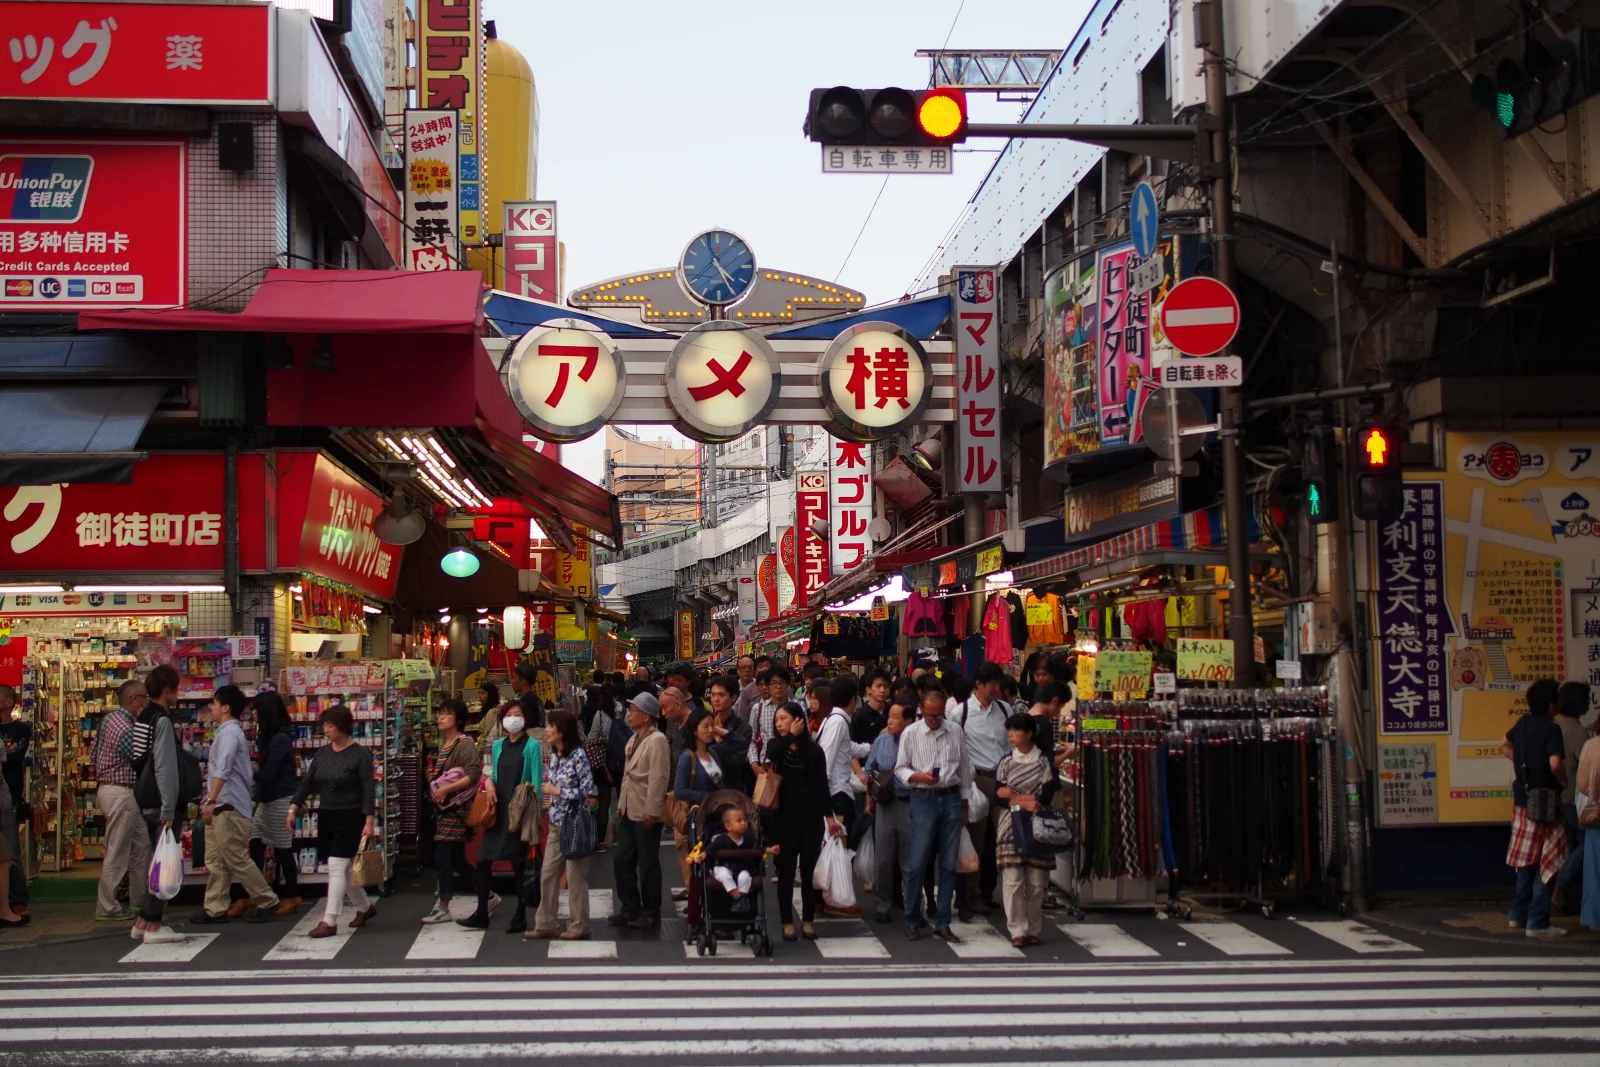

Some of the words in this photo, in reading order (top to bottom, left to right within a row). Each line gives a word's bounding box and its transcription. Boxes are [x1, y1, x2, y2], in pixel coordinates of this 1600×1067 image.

[9, 16, 118, 87] ッグ
[166, 35, 204, 71] 薬
[409, 115, 453, 138] 24時間
[829, 148, 947, 169] 自転車専用
[30, 191, 75, 208] 银联
[507, 208, 553, 231] KG
[36, 261, 71, 272] Cards
[73, 262, 130, 274] Accepted
[1101, 259, 1124, 402] センター
[537, 344, 911, 411] アメ横
[1165, 364, 1237, 383] 自転車を除く
[960, 312, 998, 486] マルセル
[800, 475, 825, 488] KG
[75, 511, 221, 548] 御徒町店
[38, 595, 59, 604] VISA
[1384, 621, 1425, 719] 徳大寺
